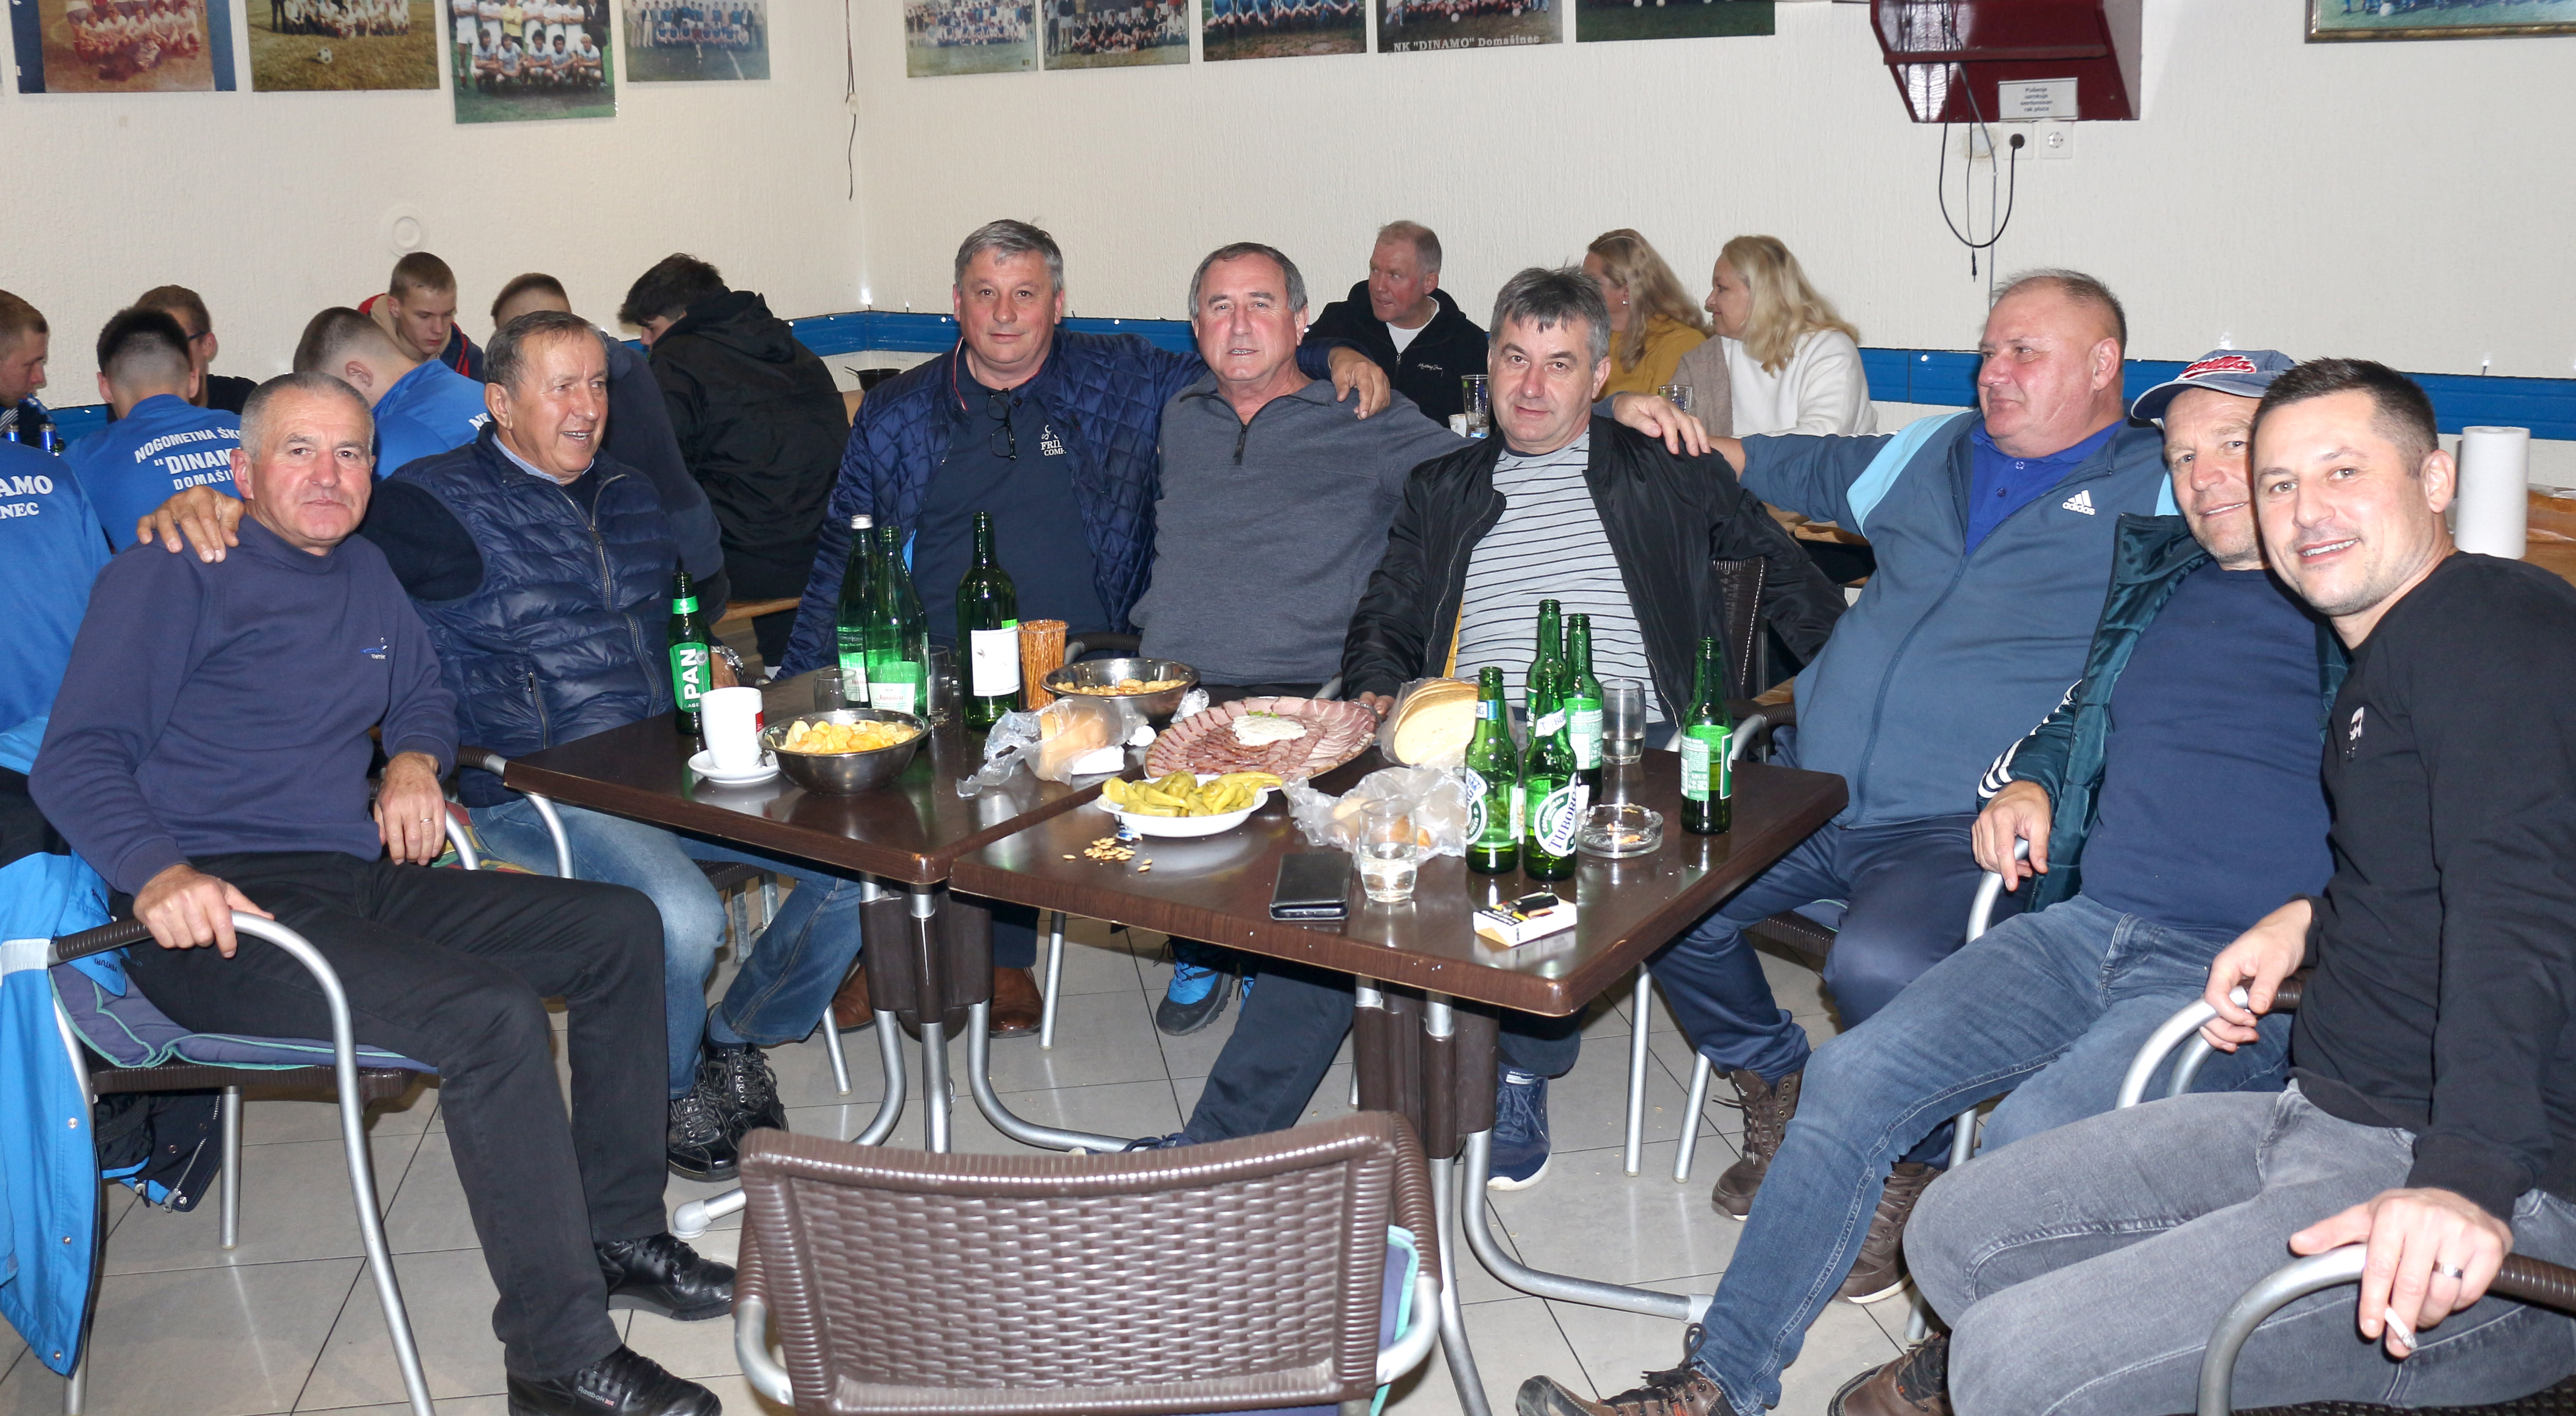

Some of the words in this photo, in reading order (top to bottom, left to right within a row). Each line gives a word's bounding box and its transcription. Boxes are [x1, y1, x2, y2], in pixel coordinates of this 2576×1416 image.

[1393, 42, 1411, 51] NK
[1414, 37, 1475, 50] "DINAMO"
[134, 429, 218, 464] NOGOMETNA
[154, 447, 241, 475] "DINAM
[2062, 501, 2095, 516] adidas
[680, 648, 701, 700] PAN
[577, 1385, 605, 1402] Reebok
